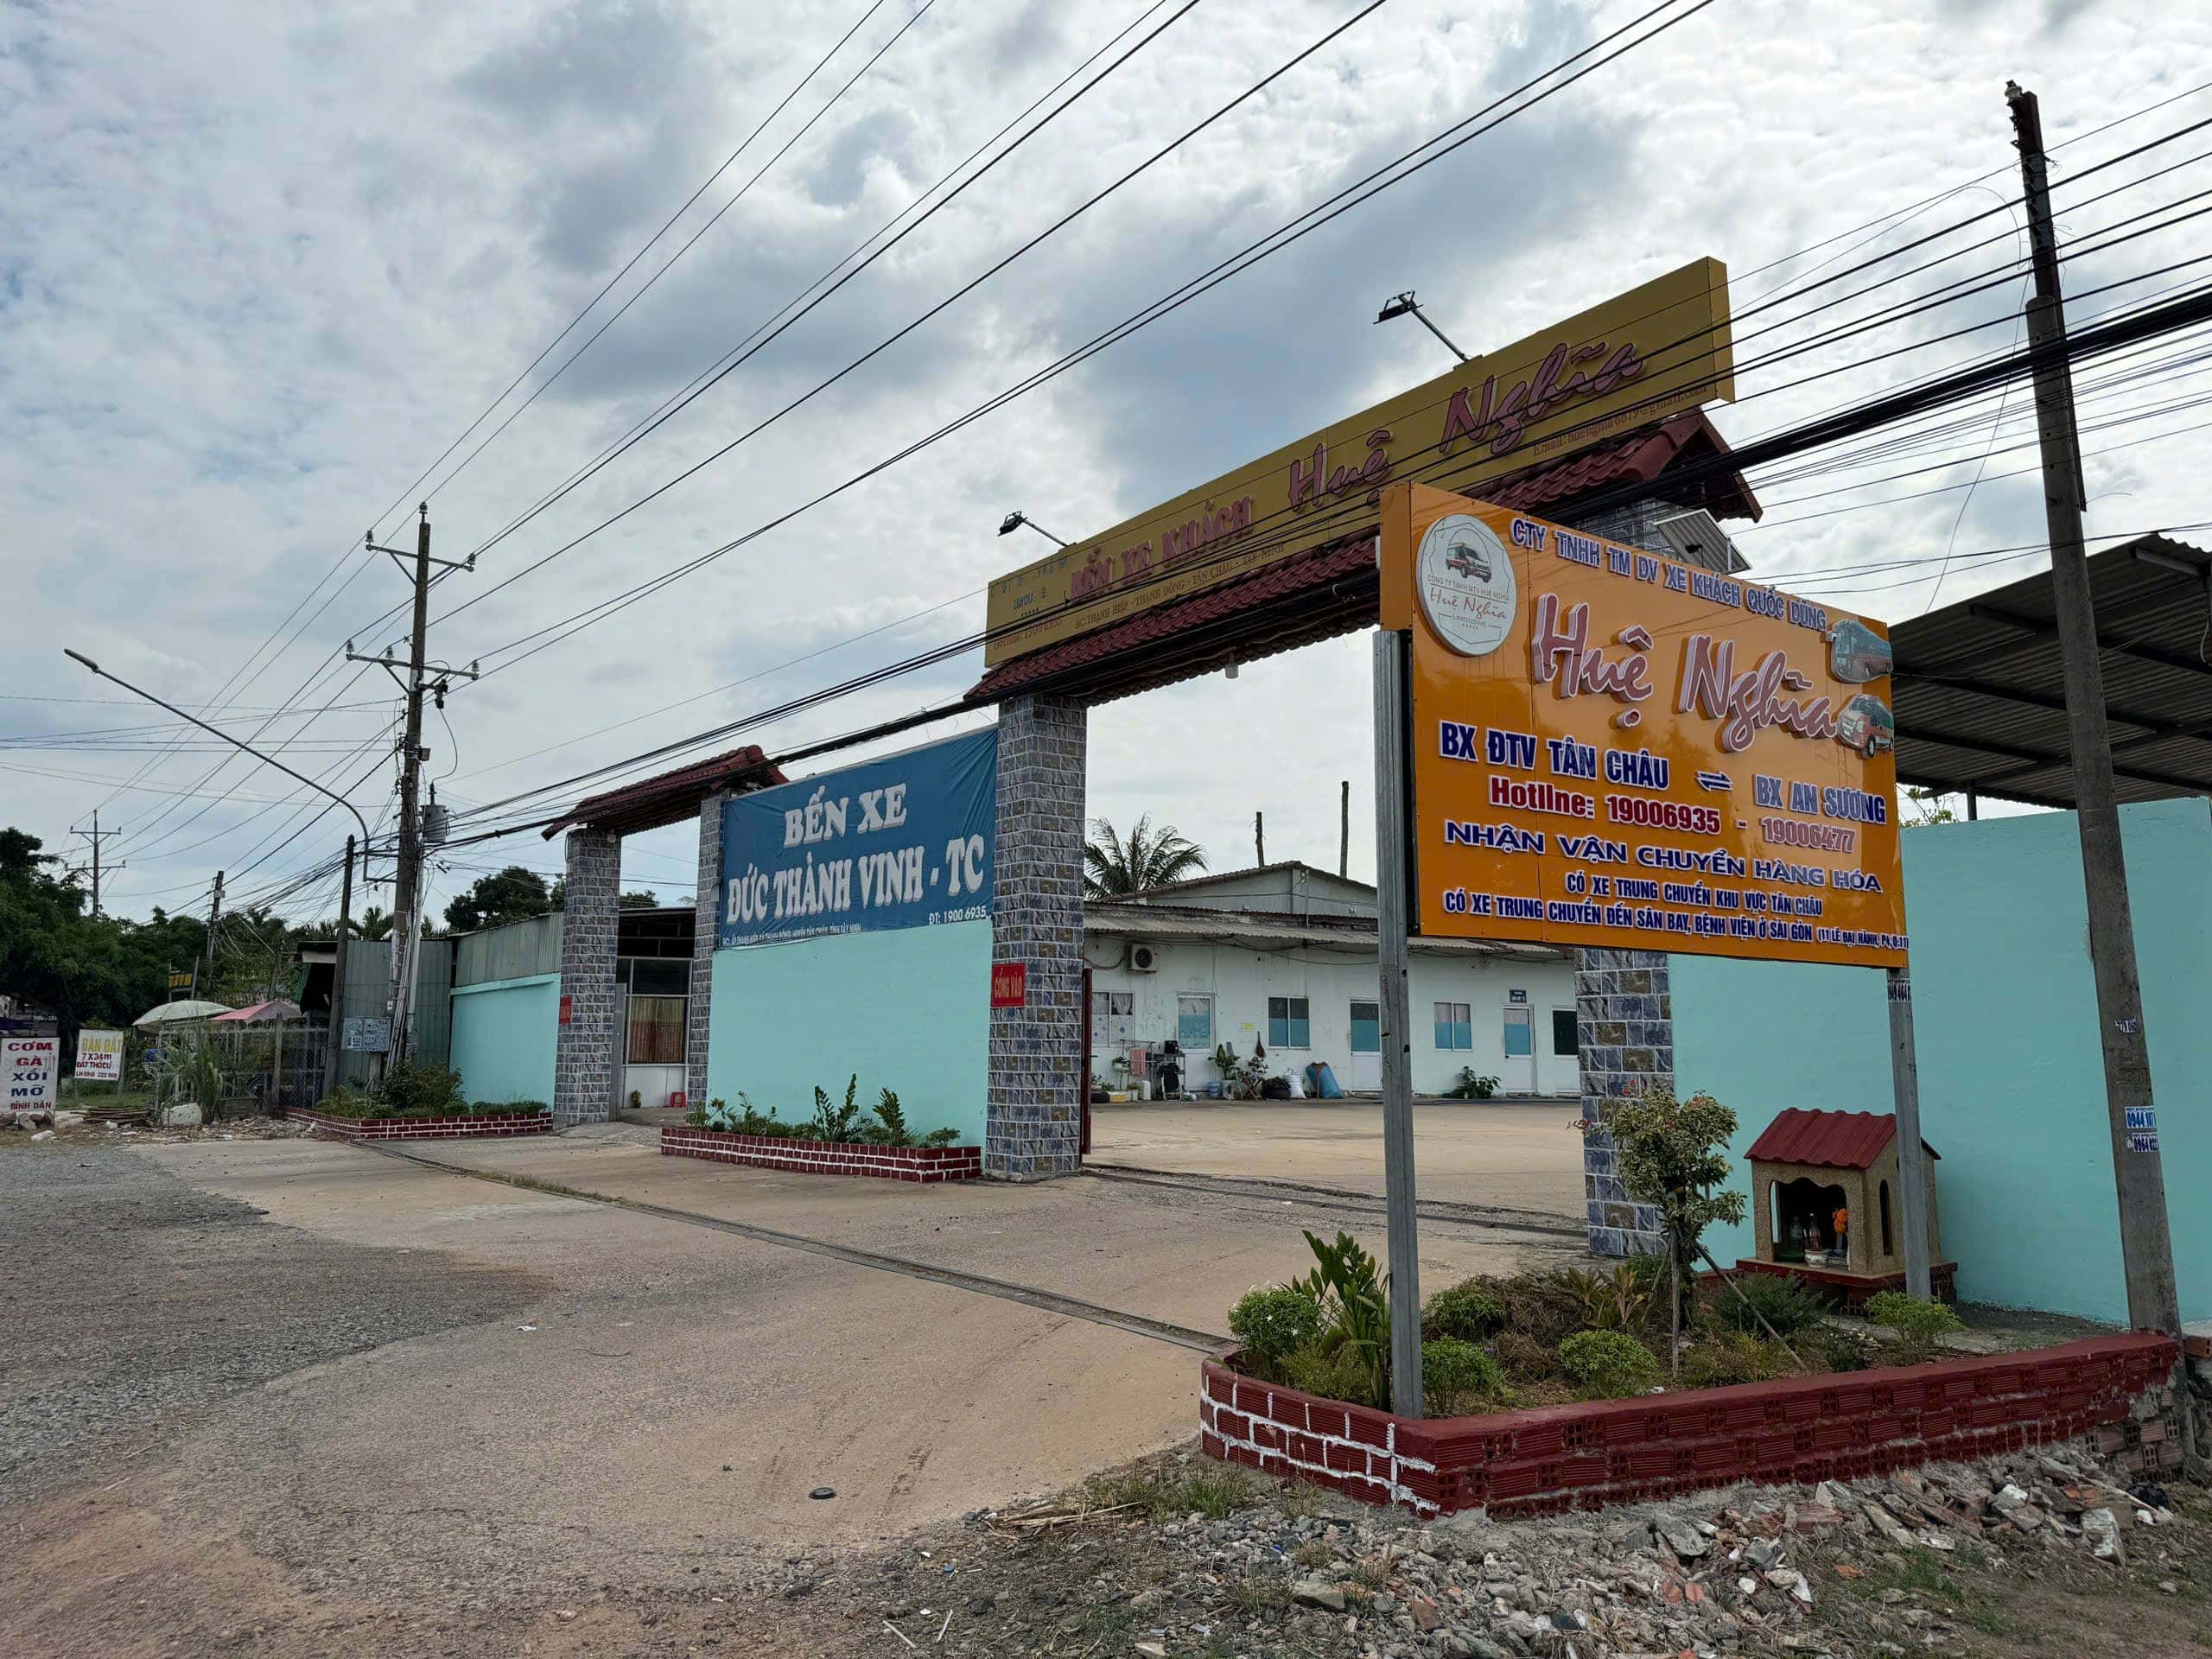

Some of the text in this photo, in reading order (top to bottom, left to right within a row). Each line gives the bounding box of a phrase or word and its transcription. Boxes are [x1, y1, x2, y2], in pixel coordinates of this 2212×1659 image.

[1121, 539, 1153, 584] XE
[1161, 498, 1253, 567] KHÁCH
[1287, 430, 1393, 512] Huệ
[1439, 342, 1645, 454] Nghĩa
[1511, 518, 1547, 551] CTY
[1554, 531, 1601, 567] TNHH
[1607, 547, 1631, 575] TM
[1637, 555, 1658, 582] DV
[1665, 563, 1686, 592] XE
[1691, 572, 1741, 607] KHÁCH
[1745, 584, 1784, 620] QUỐC
[1534, 593, 1838, 753] Huệ Nghĩa
[1439, 720, 1886, 824] BX ĐTV TÂN CHÂU BX AN SƯƠNG
[784, 782, 908, 848] BẾN XE
[1488, 774, 1856, 853] Hotline: 19006935 - 19006477
[726, 834, 985, 925] ĐỨC THÀNH VINH - TC
[1444, 818, 1883, 893] NHẬN VẬN CHUYỂN HÀNG HÓA
[944, 909, 963, 924] 1900
[964, 906, 987, 920] 6935
[1444, 887, 1467, 913] CÓ
[1470, 892, 1491, 916] XE
[1494, 894, 1544, 919] TRUNG
[1548, 897, 1601, 925] CHUYỂN
[1605, 900, 1633, 927] ĐẾN
[1636, 906, 1663, 931] SÂN
[1667, 912, 1692, 935] BAY,
[1694, 912, 1726, 939] BỆNH
[1729, 914, 1757, 940] VIỆN
[1758, 917, 1767, 940] Ở
[1770, 918, 1788, 939] SÀI
[1789, 921, 1813, 942] GÒN
[1565, 869, 1822, 917] CÓ XE TRUNG CHUYỂN KHU VỰC TÂN CHÂU
[8, 1041, 53, 1052] CƠM
[12, 1068, 48, 1081] XỐI
[16, 1055, 42, 1066] GÀ
[10, 1084, 45, 1096] MỠ
